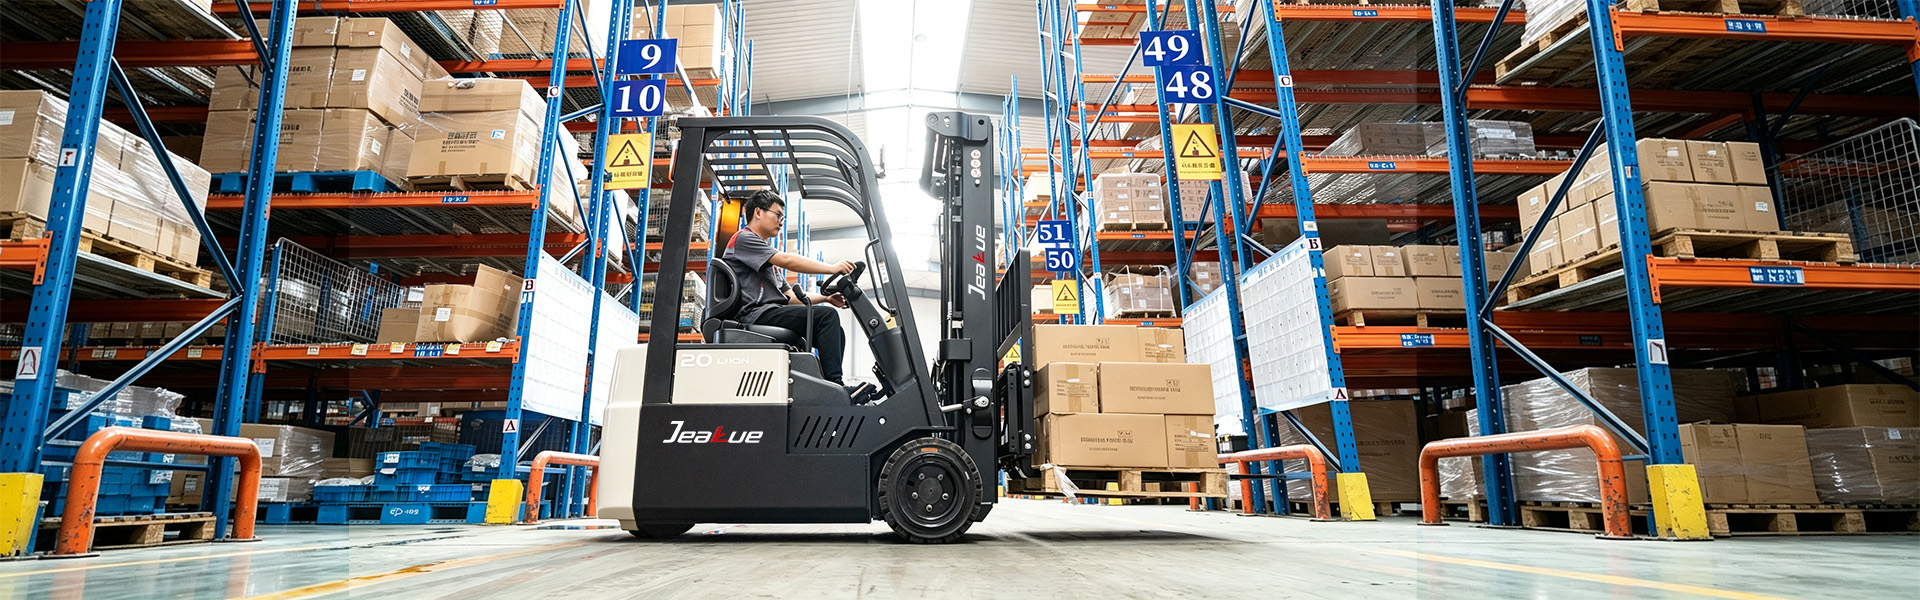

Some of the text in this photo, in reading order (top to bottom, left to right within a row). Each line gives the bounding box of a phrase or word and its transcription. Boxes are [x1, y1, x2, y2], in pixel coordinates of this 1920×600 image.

[641, 44, 662, 70] 9
[1144, 34, 1190, 62] 49
[1165, 70, 1213, 99] 48
[615, 84, 661, 113] 10
[1039, 224, 1066, 241] 51
[1048, 250, 1075, 269] 50
[524, 279, 534, 291] B
[680, 353, 713, 368] 20
